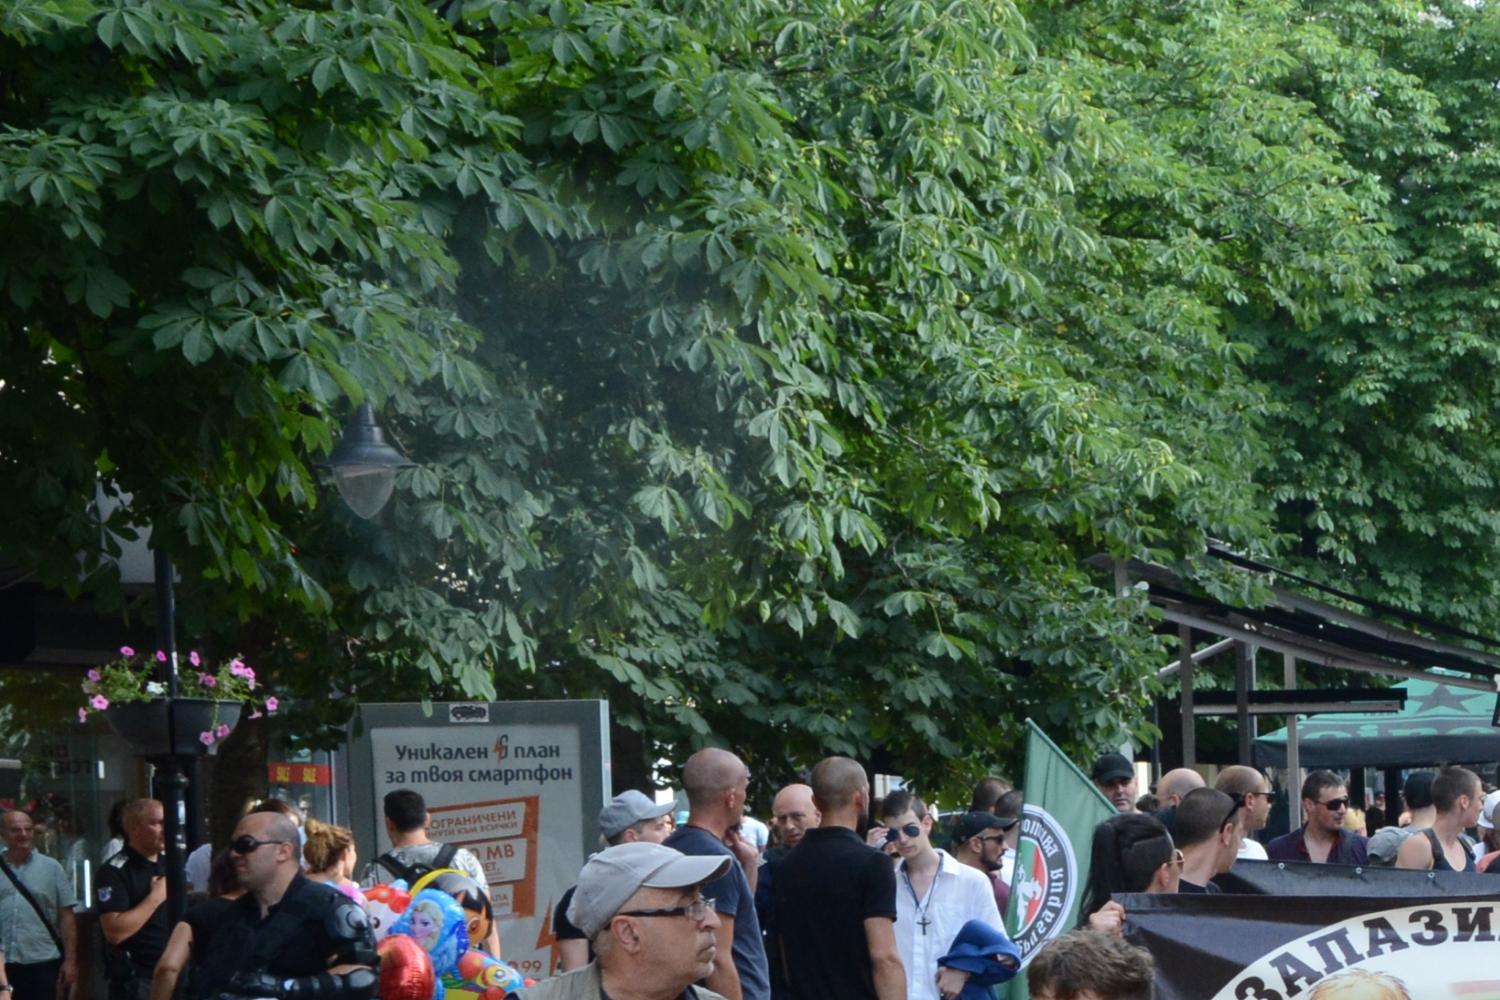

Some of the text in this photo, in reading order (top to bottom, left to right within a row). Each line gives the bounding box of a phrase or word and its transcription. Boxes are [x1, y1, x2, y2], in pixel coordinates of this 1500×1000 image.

[395, 743, 488, 760] Уникален
[514, 744, 560, 759] план
[385, 763, 573, 785] за твоя смартфон
